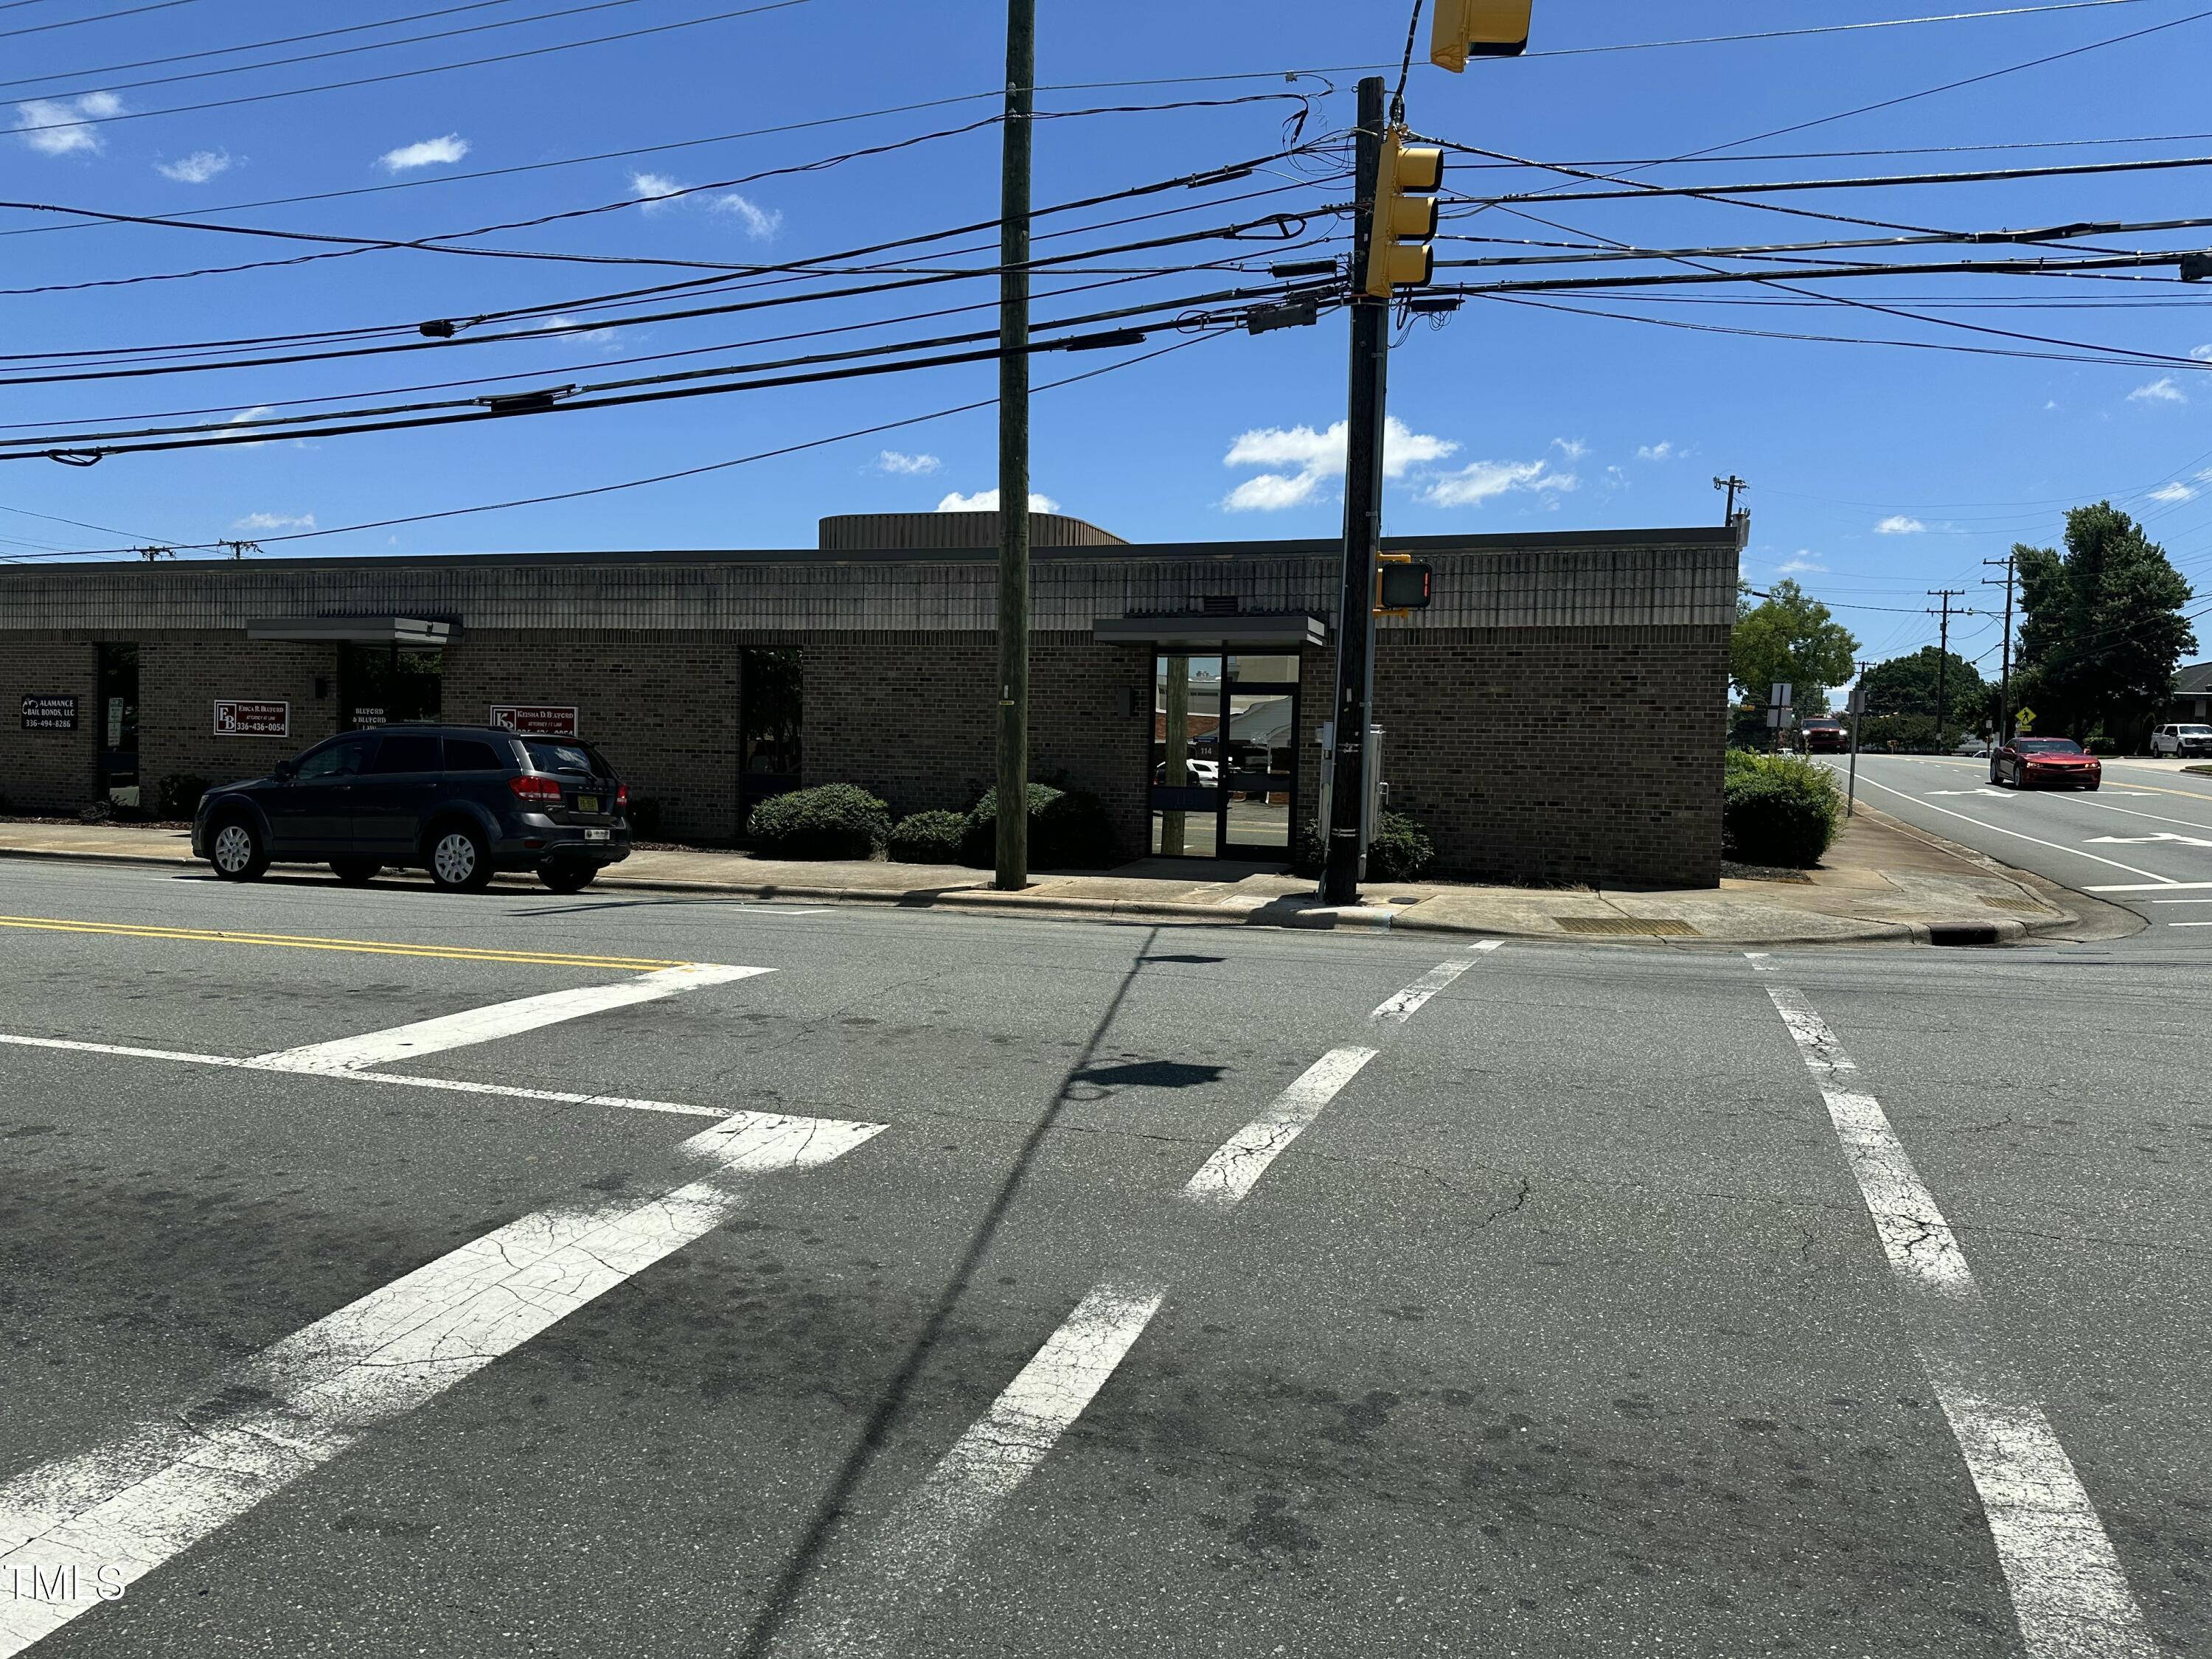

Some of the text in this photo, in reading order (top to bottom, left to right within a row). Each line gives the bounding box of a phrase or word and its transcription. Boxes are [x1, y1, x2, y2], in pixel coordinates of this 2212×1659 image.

[41, 709, 63, 717] BONDS,
[64, 709, 75, 717] LLC
[517, 710, 540, 718] KEISHA
[26, 720, 71, 728] 336-494-8286
[237, 723, 285, 731] 336-436-0054
[1200, 747, 1212, 755] 114
